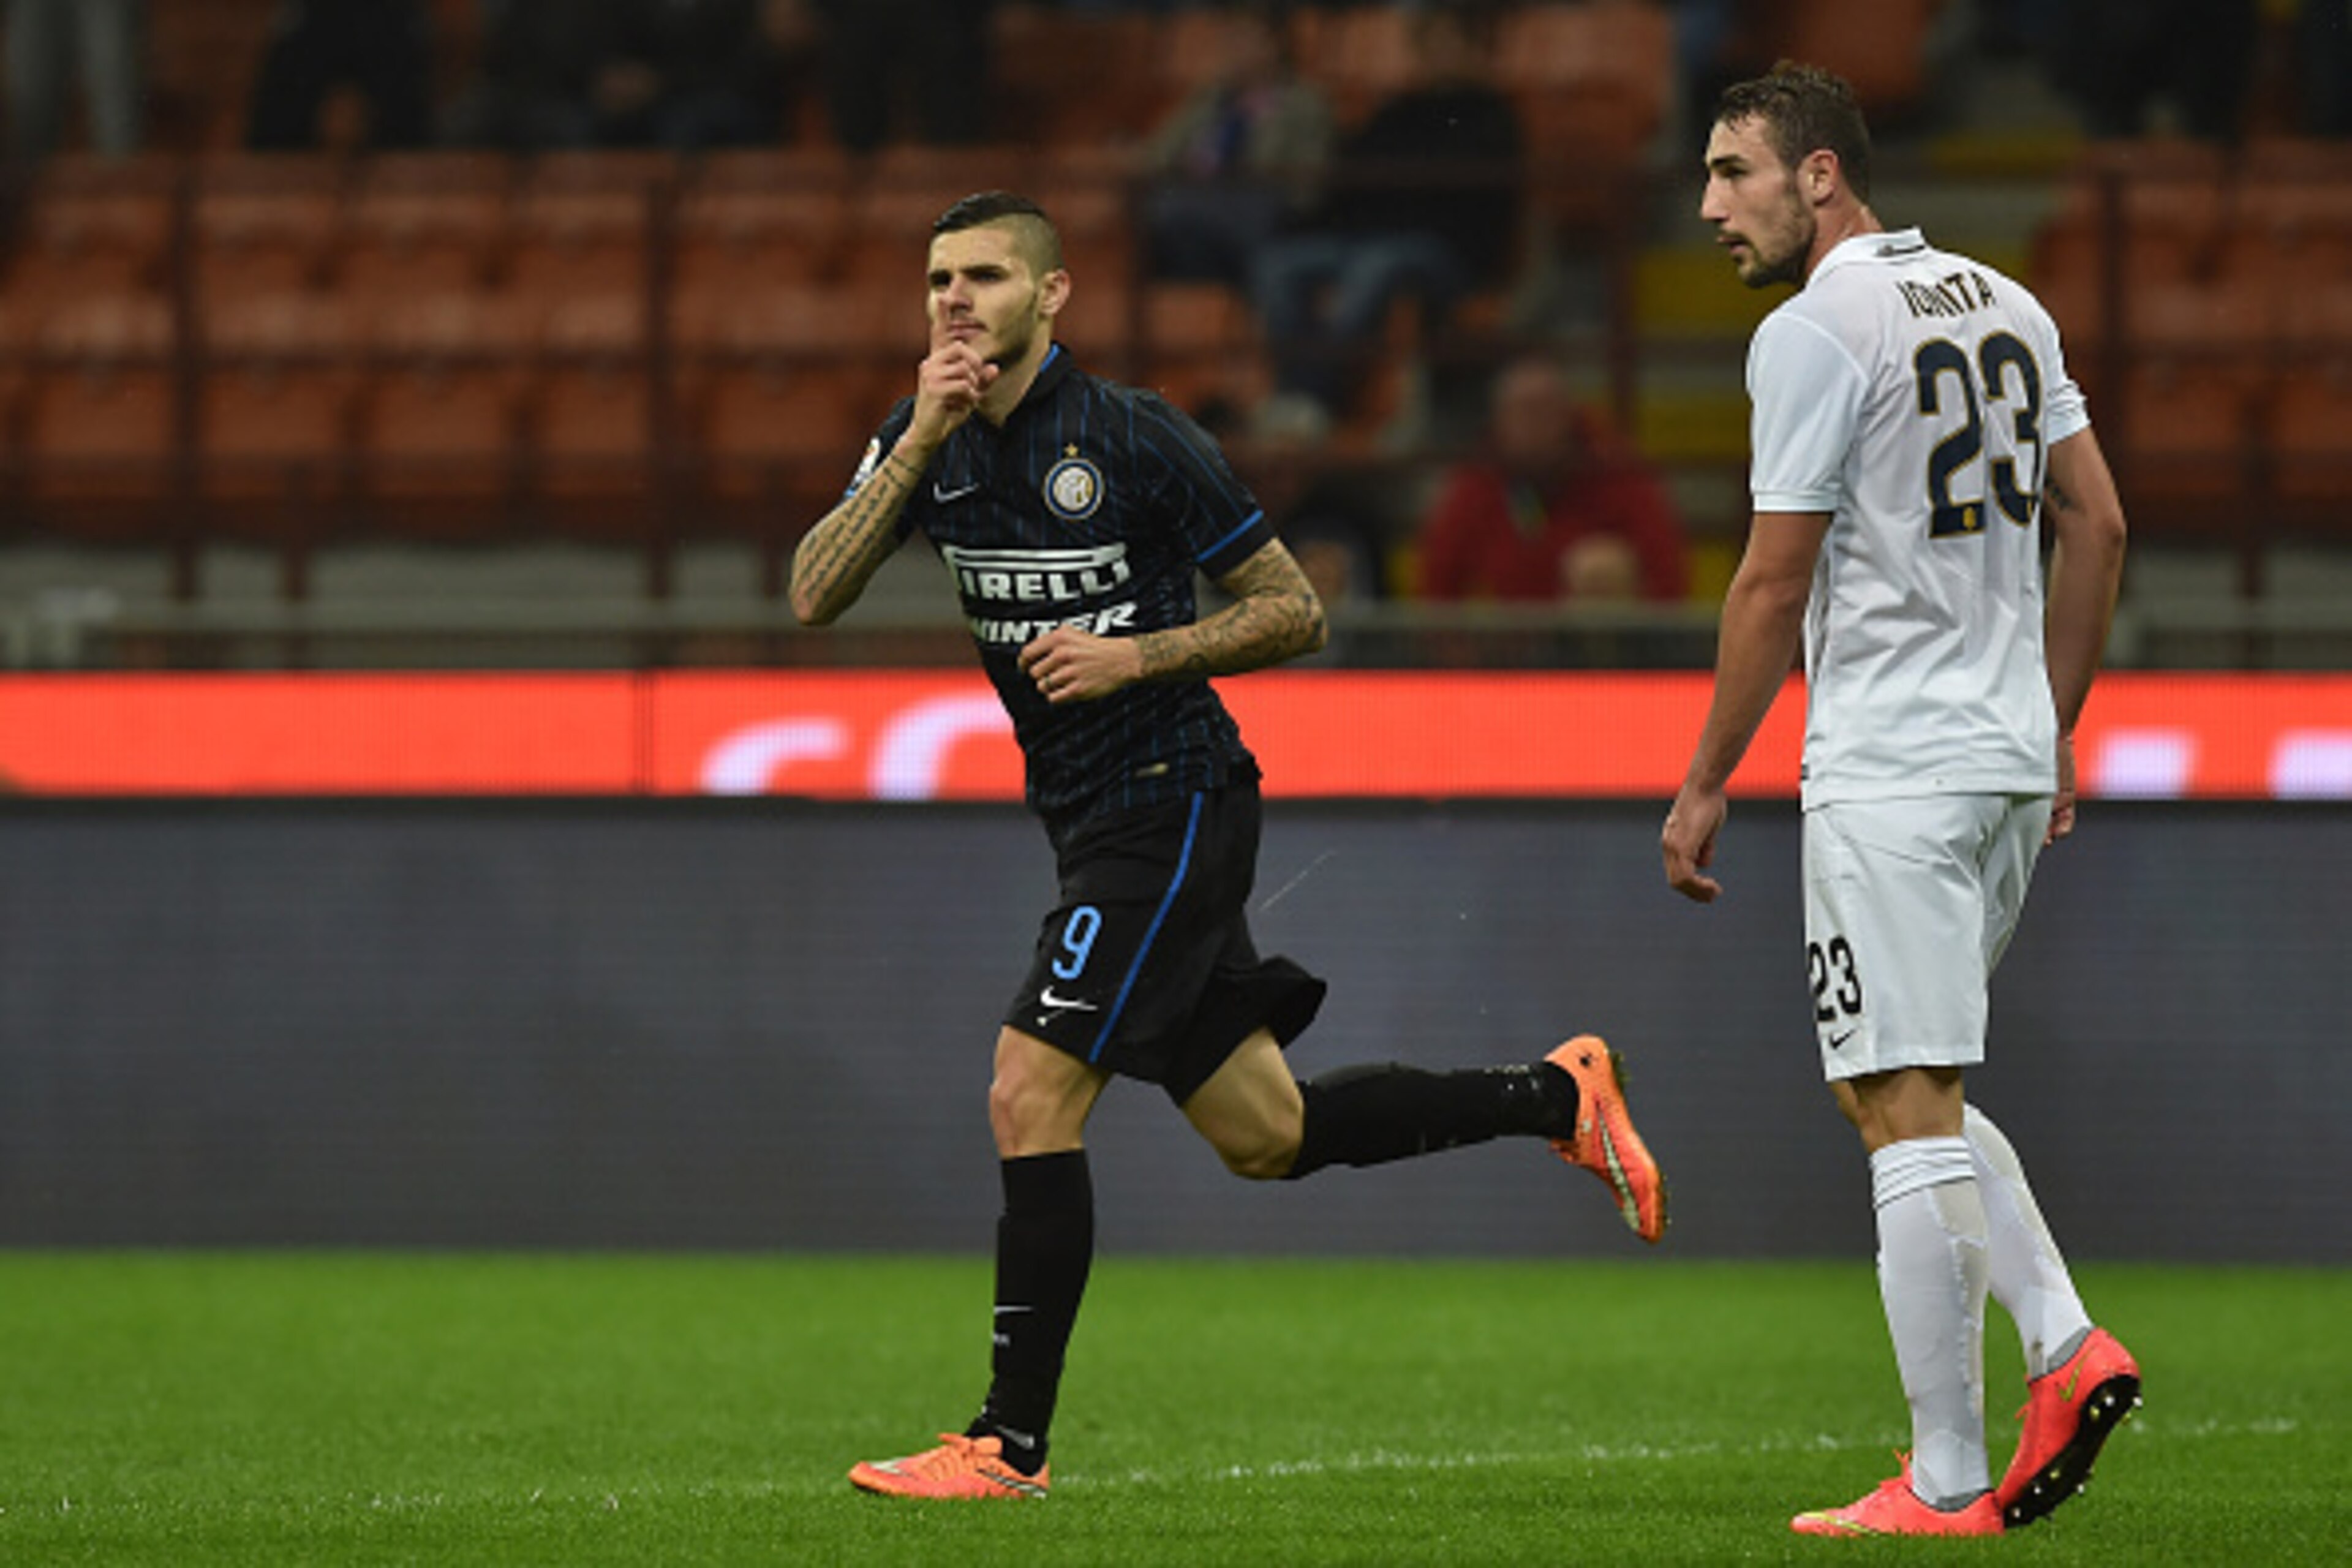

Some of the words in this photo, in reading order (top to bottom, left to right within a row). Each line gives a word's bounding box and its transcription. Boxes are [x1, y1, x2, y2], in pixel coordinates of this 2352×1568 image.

[1913, 329, 2042, 538] 23
[1052, 906, 1102, 980] 9
[1809, 935, 1862, 1022] 23
